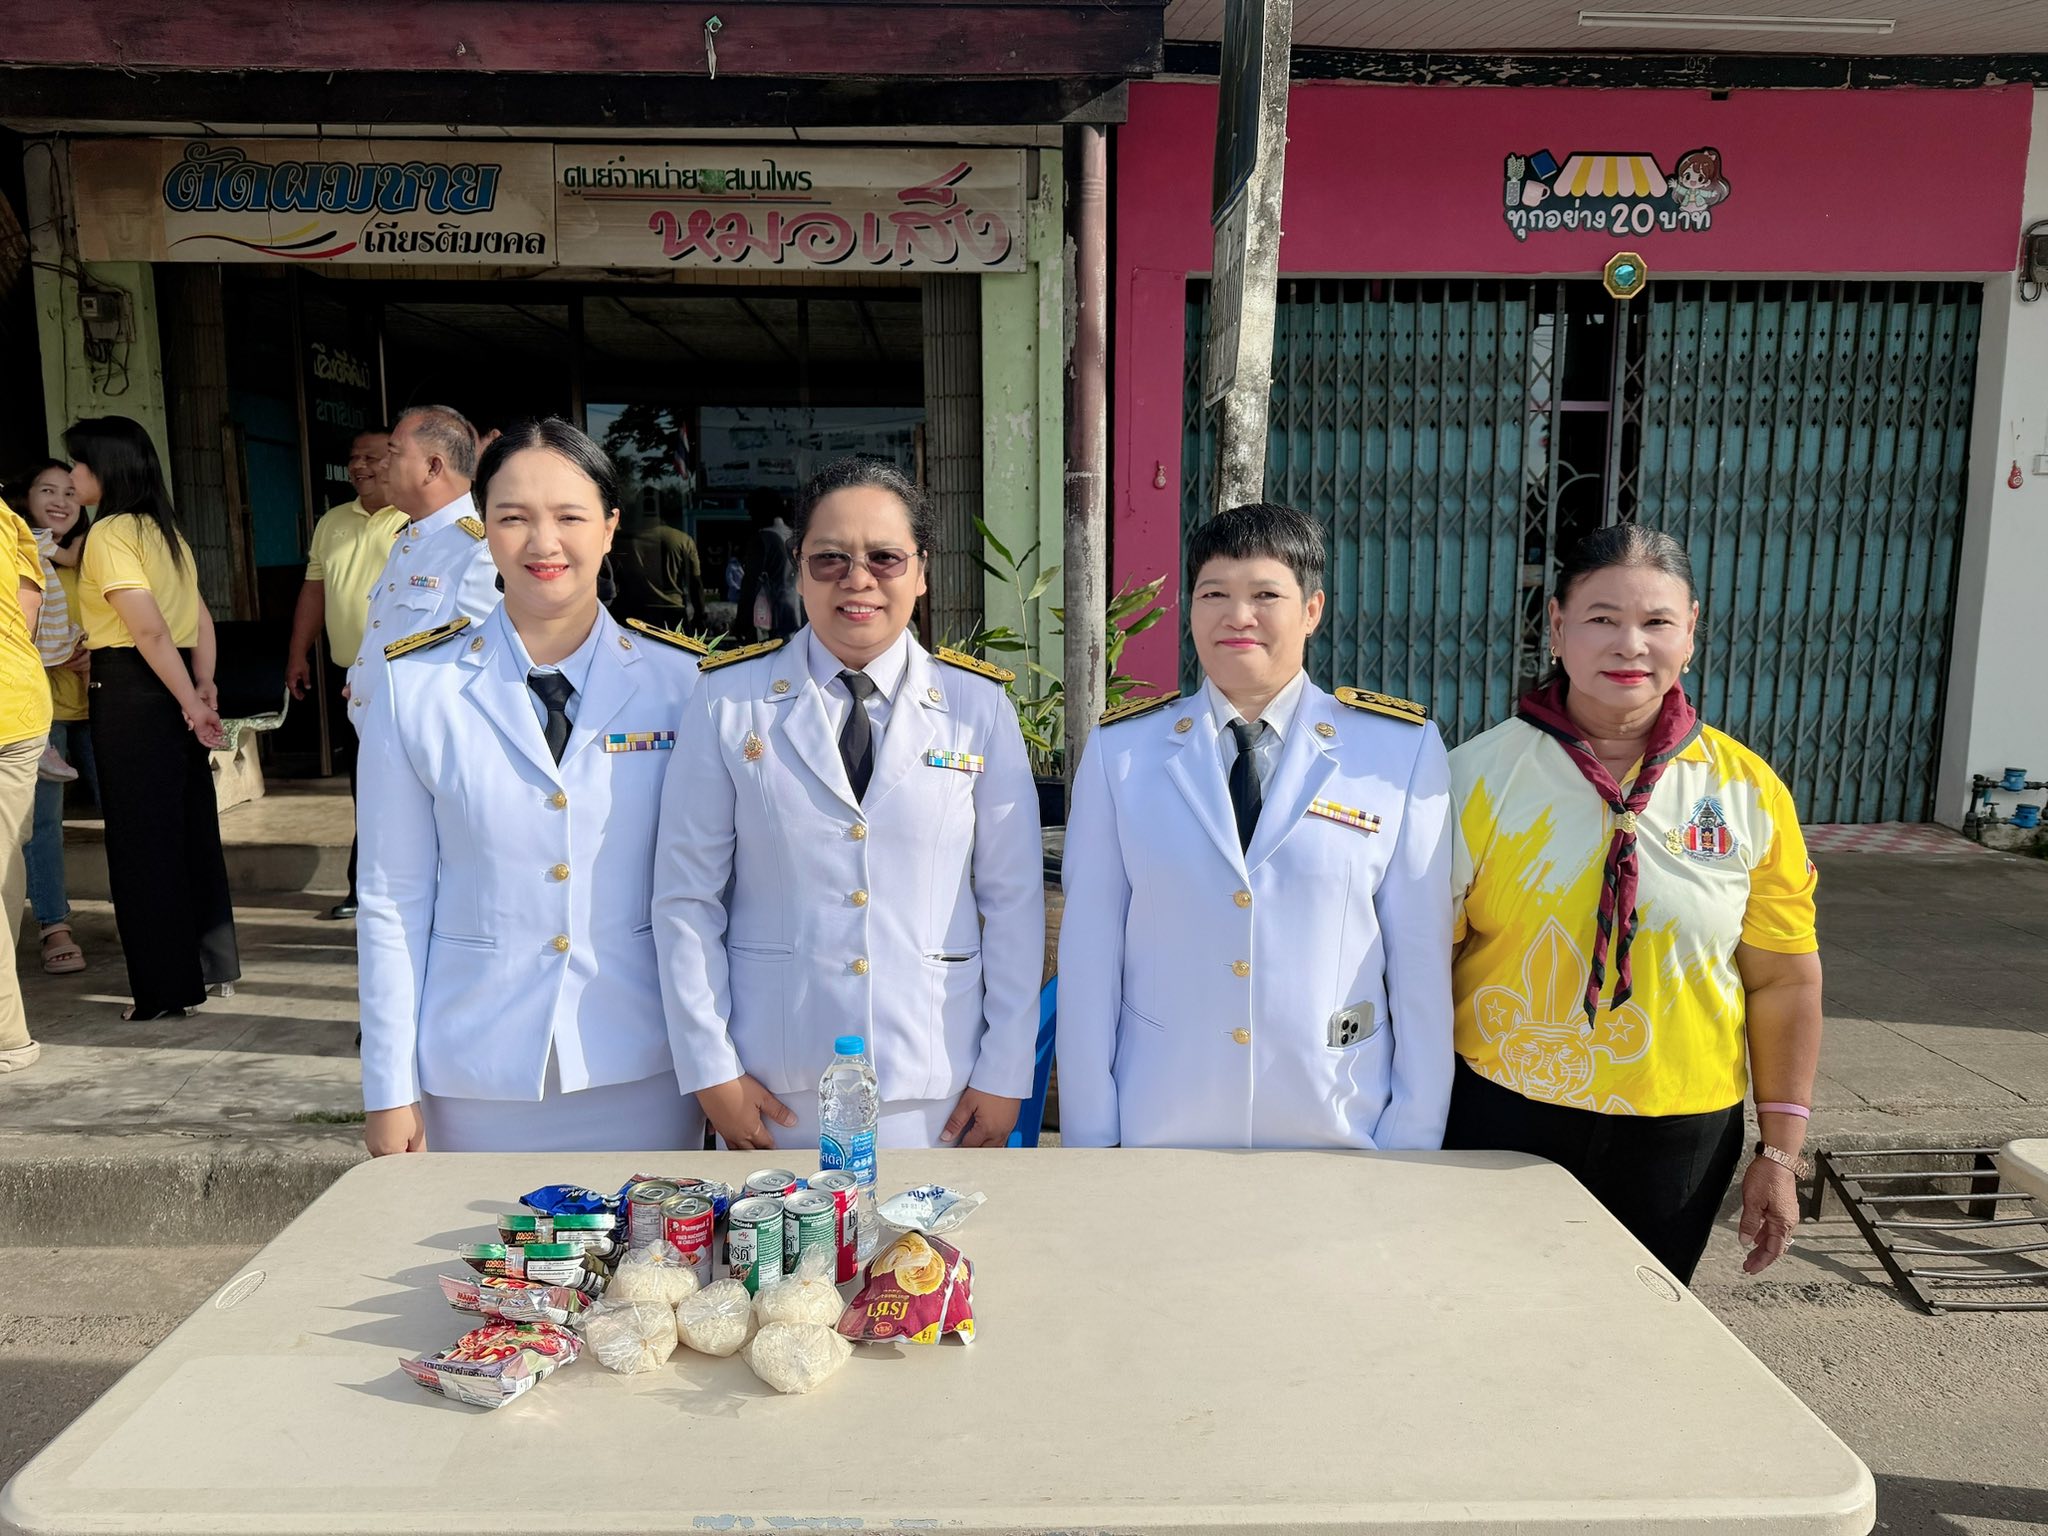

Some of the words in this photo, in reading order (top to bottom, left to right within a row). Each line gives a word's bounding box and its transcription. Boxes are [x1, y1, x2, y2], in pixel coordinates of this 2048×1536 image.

[163, 142, 501, 214] ตัดผมชาย
[364, 221, 546, 255] เกียรติมงคล
[1506, 199, 1607, 239] ทุกอย่าง
[1610, 203, 1655, 233] 20
[1659, 210, 1711, 230] บาท
